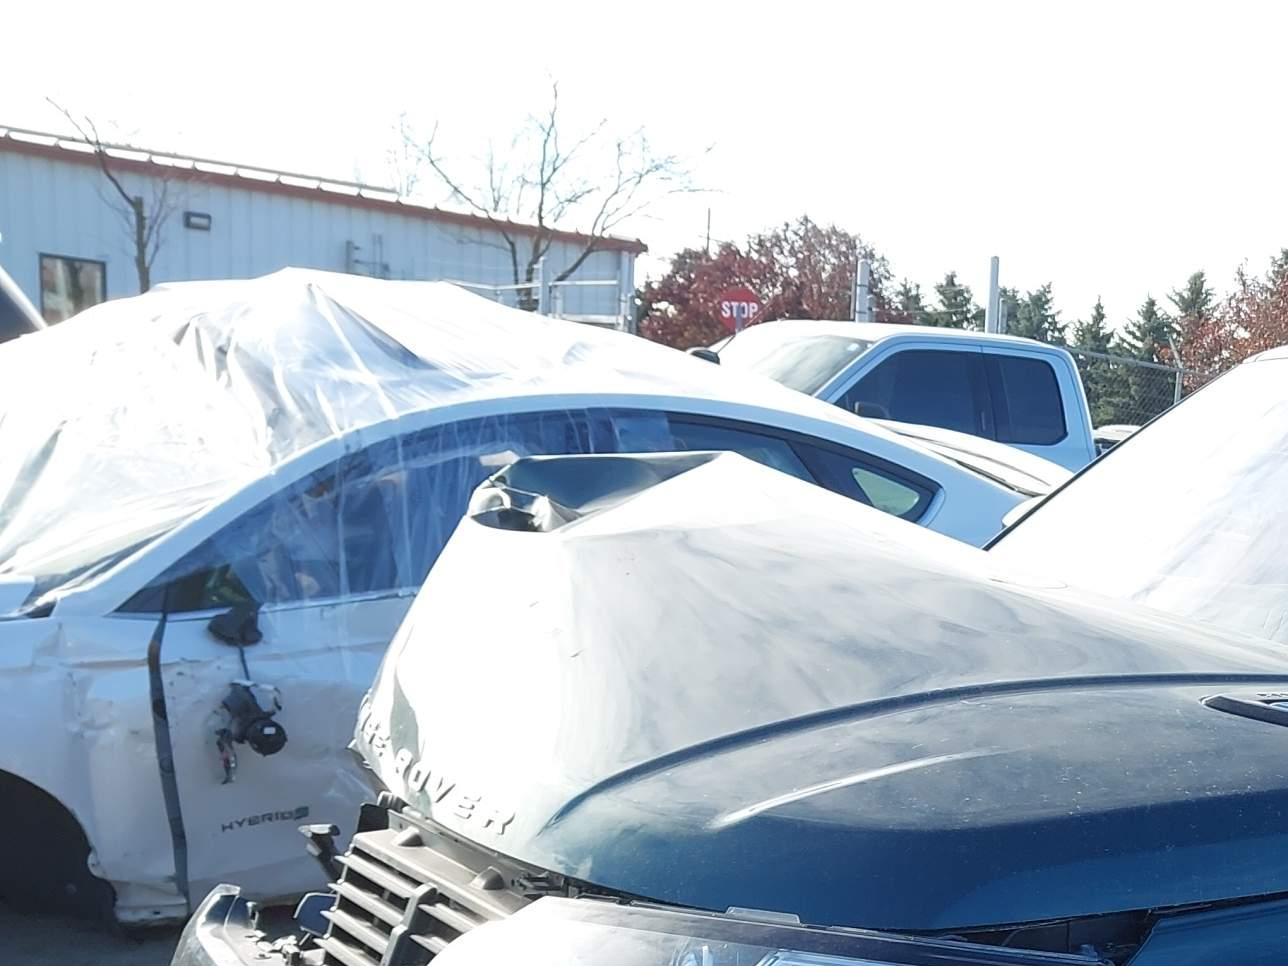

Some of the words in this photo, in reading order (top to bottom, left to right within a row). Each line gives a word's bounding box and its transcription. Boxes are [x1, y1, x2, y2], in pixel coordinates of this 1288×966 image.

[721, 301, 758, 318] STOP
[396, 747, 517, 836] ROVER
[221, 812, 294, 832] HYBRID
